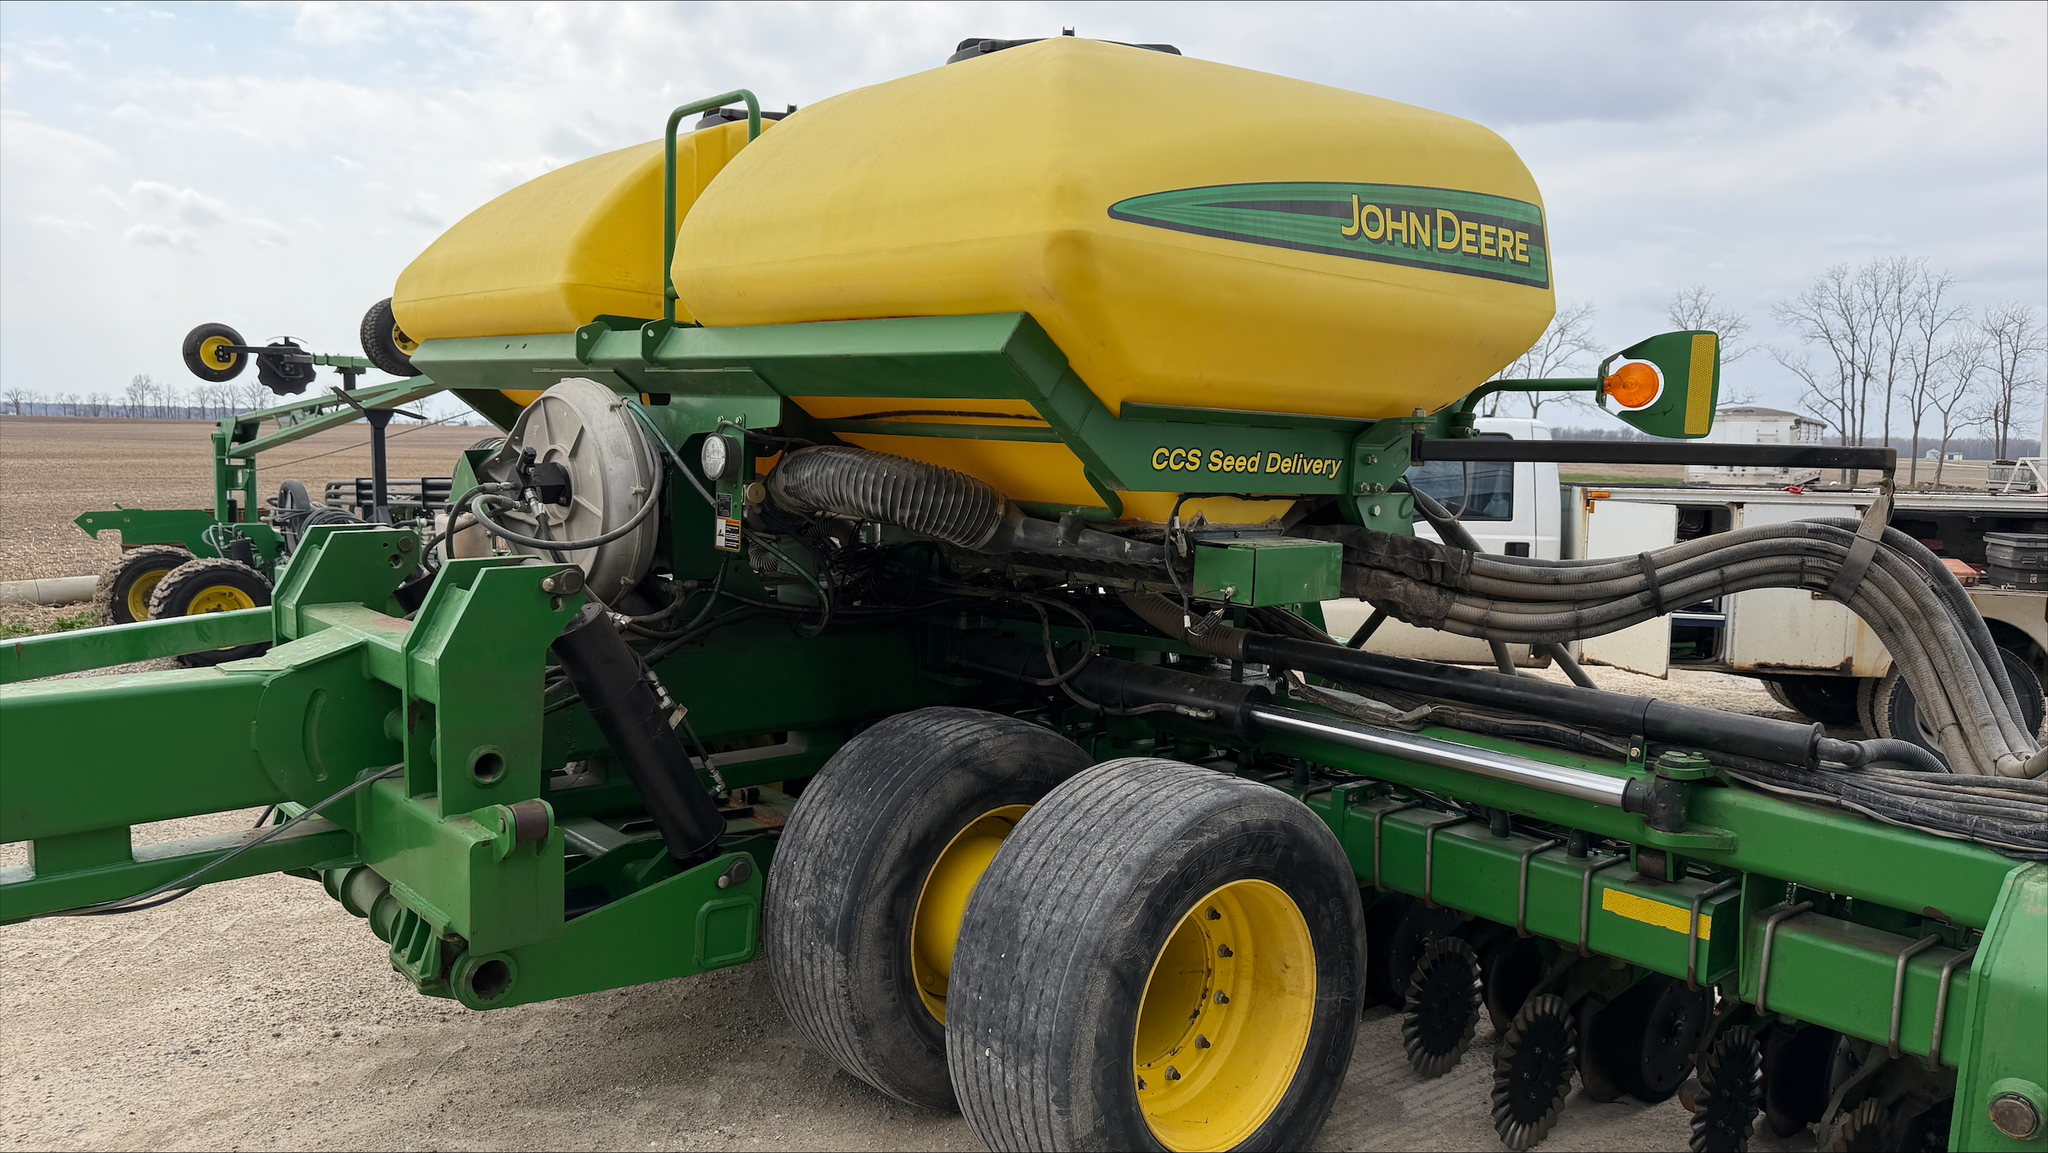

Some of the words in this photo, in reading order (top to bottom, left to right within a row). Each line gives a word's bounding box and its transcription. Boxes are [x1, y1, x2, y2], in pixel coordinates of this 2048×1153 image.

[1341, 193, 1432, 248] JOHN
[1437, 209, 1530, 264] DEERE
[1152, 446, 1203, 472] CCS
[1208, 449, 1261, 473] Seed
[1265, 451, 1343, 479] Delivery
[1147, 834, 1285, 941] MICHELIN
